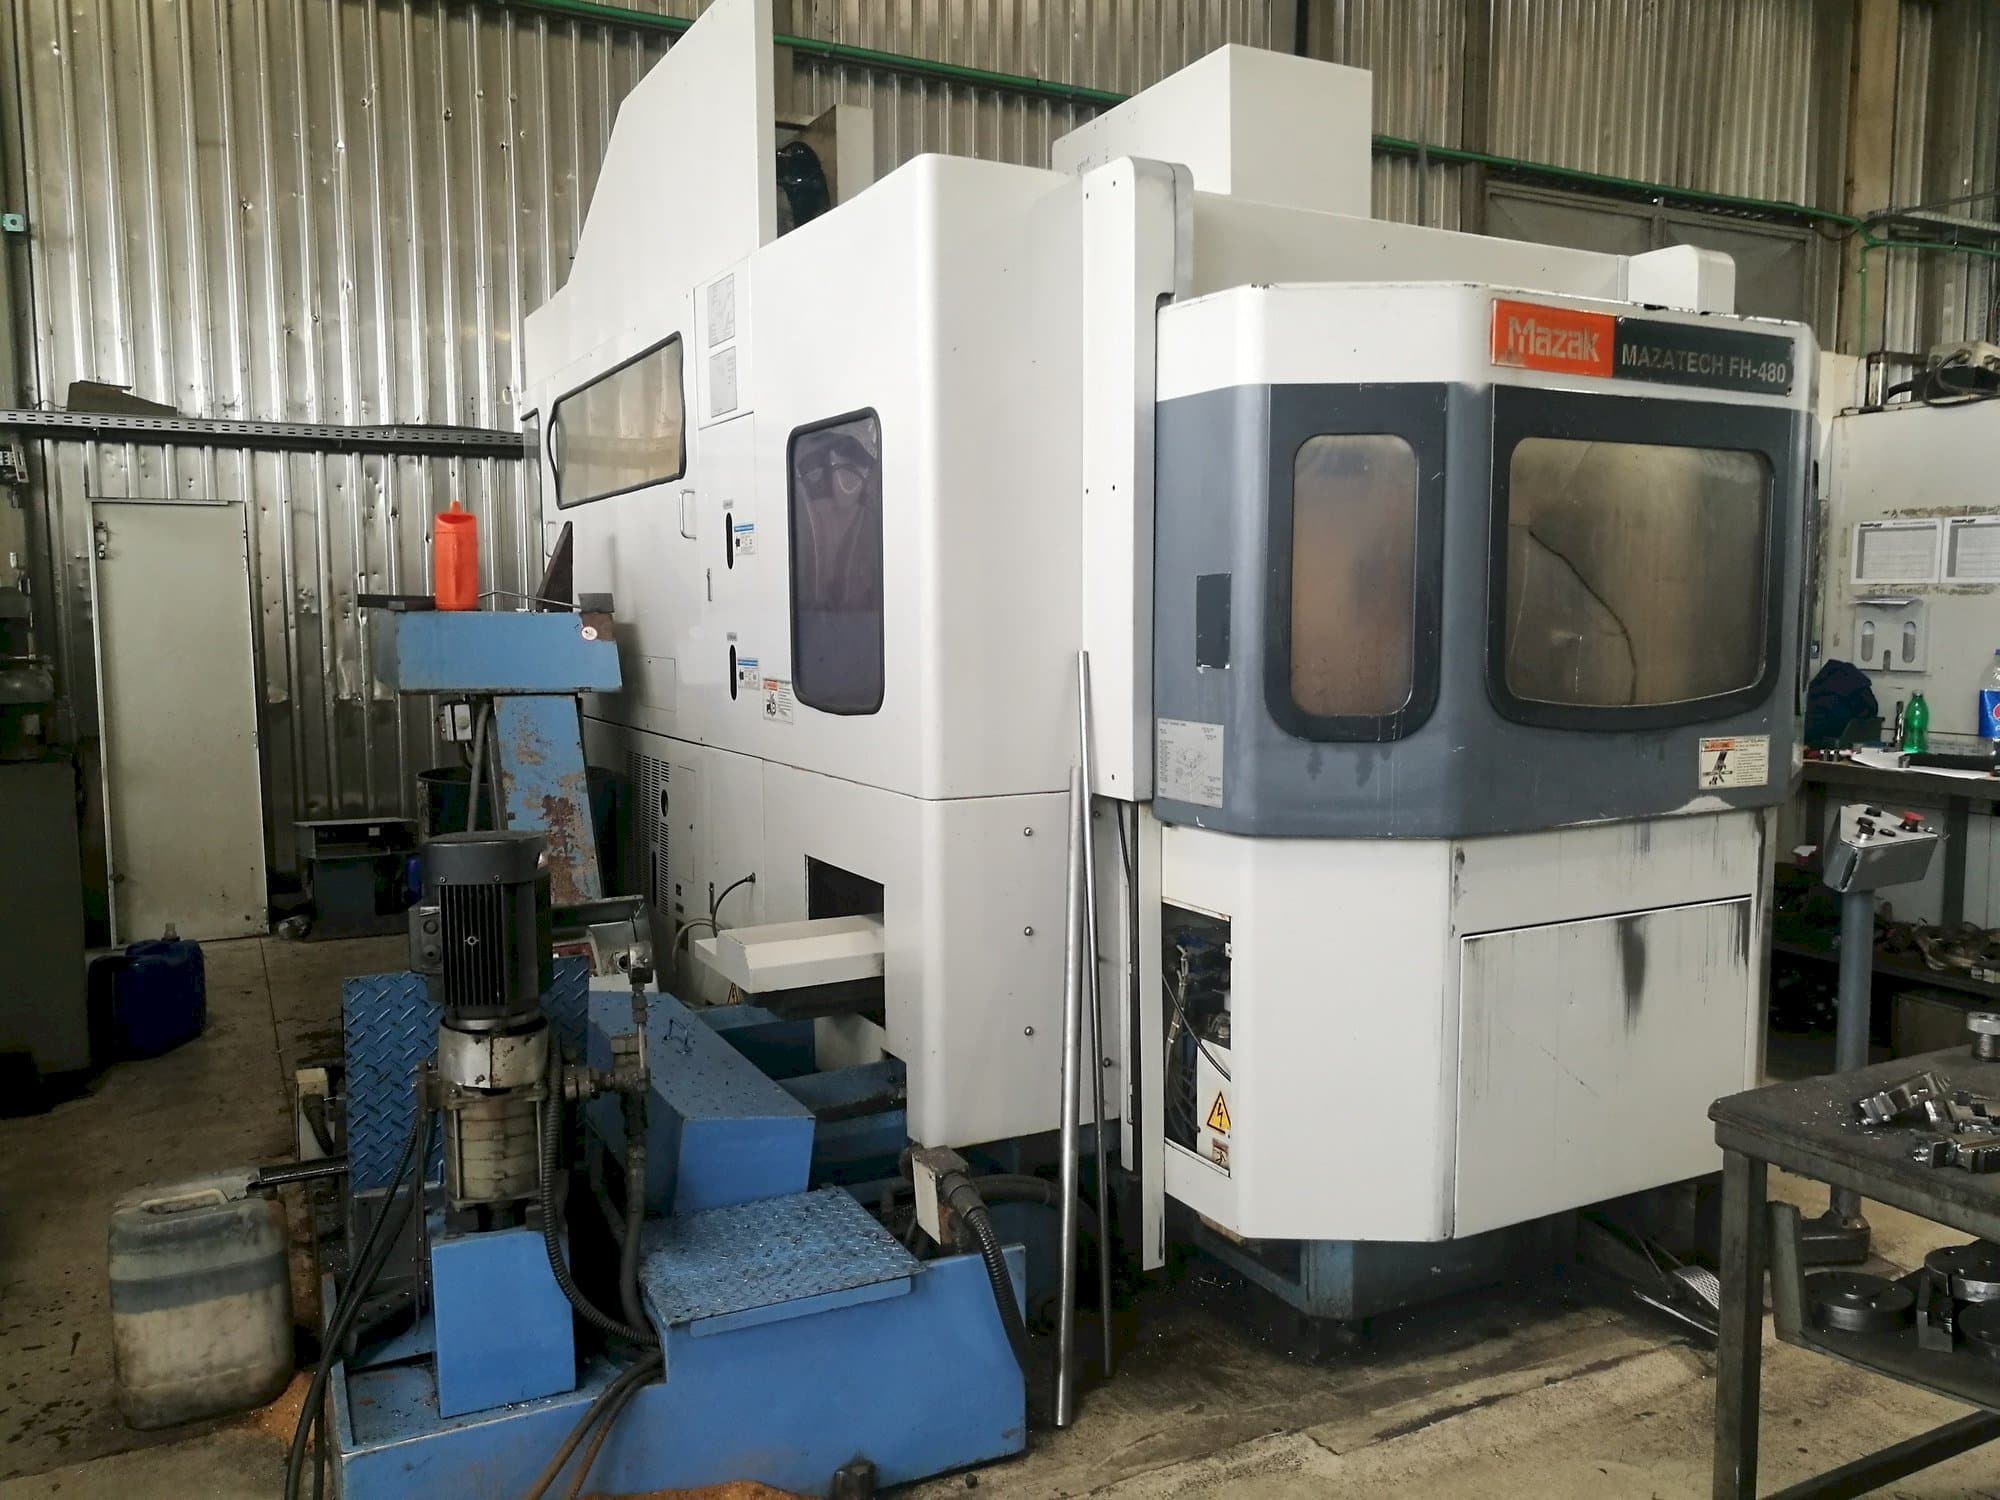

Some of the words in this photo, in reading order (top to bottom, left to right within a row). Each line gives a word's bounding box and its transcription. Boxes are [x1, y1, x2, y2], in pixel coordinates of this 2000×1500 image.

[1507, 316, 1600, 362] Mazak
[1622, 343, 1724, 375] MAZATECH
[1728, 358, 1786, 384] FH-480
